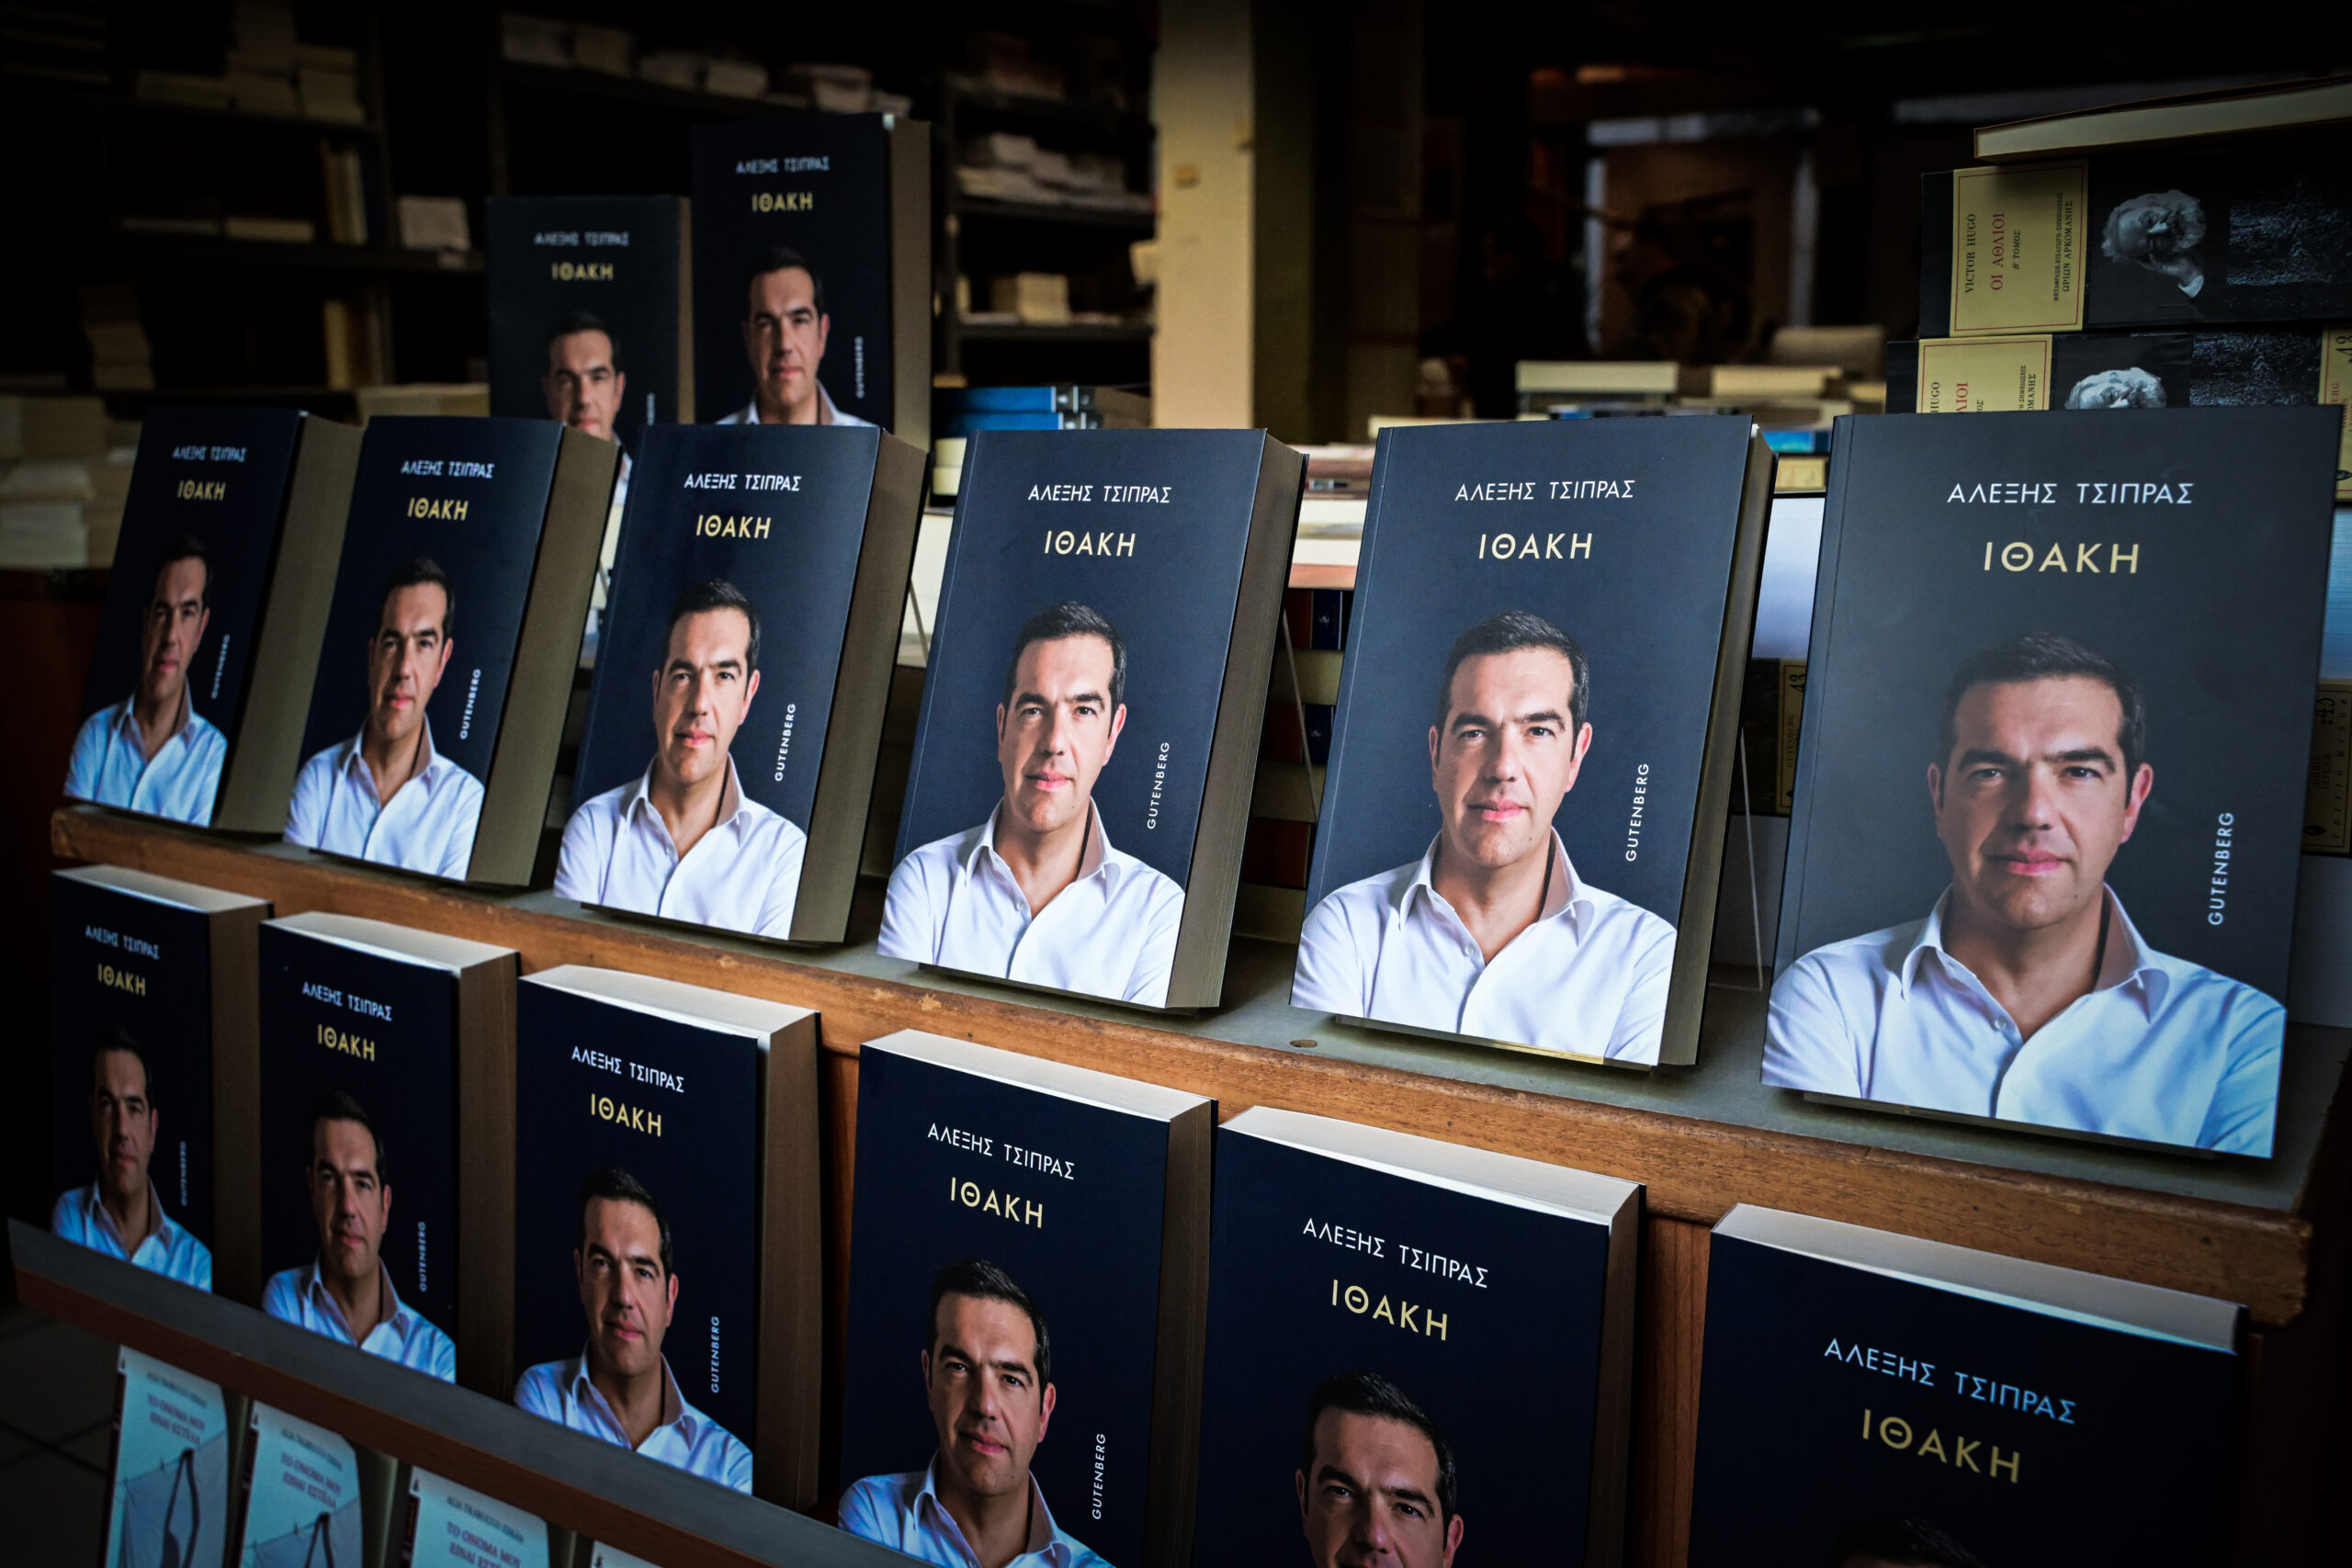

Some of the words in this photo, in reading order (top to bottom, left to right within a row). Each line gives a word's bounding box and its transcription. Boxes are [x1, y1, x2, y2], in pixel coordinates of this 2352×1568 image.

[752, 190, 813, 212] ΙΘΑΚΗ
[1966, 213, 1977, 246] HUGO
[1992, 212, 2006, 268] ΑΘΛΙΟΙ
[2012, 230, 2022, 260] ΤΟΜΟΣ
[1964, 251, 1976, 294] VICTOR
[1991, 275, 2004, 291] ΟΙ
[2063, 262, 2071, 292] ΩΡΙΩΝ
[1955, 382, 1969, 413] ΛΙΟΙ
[401, 460, 444, 476] ΑΛΕΞΗΣ
[447, 461, 495, 479] ΤΣΙΠΡΑΣ
[684, 473, 738, 490] ΑΛΕΞΗΣ
[745, 474, 802, 492] ΤΣΙΠΡΑΣ
[177, 479, 226, 501] ΙΘΑΚΗ
[407, 497, 469, 521] ΙΘΑΚΗ
[1027, 484, 1094, 502] ΑΛΕΞΗΣ
[1103, 485, 1172, 503] ΤΣΙΠΡΑΣ
[1455, 482, 1535, 501] ΑΛΕΞΗΣ
[1550, 480, 1634, 499] ΤΣΙΠΡΑΣ
[1948, 483, 2057, 503] ΑΛΕΞΗΣ
[2077, 483, 2193, 503] ΤΣΙΠΡΑΣ
[695, 514, 772, 539] ΙΘΑΚΗ
[1044, 530, 1136, 558] ΙΘΑΚΗ
[1479, 534, 1592, 558] ΙΘΑΚΗ
[1984, 542, 2138, 573] ΙΘΑΚΗ
[459, 668, 481, 740] GUTENBERG
[775, 703, 797, 782] GUTENBERG
[1147, 742, 1170, 829] GUTENBERG
[1626, 764, 1648, 861] GUTENBERG
[2208, 813, 2233, 925] GUTENBERG
[97, 964, 146, 997] ΙΘΑΚΗ
[301, 981, 343, 1009] ΑΛΕΞΗΣ
[347, 994, 392, 1022] ΤΣΙΠΡΑΣ
[317, 1022, 375, 1062] ΙΘΑΚΗ
[571, 1045, 622, 1077] ΑΛΕΞΗΣ
[628, 1062, 684, 1093] ΤΣΙΠΡΑΣ
[591, 1093, 662, 1137] ΙΘΑΚΗ
[927, 1122, 993, 1159] ΑΛΕΞΗΣ
[1003, 1144, 1075, 1180] ΤΣΙΠΡΑΣ
[950, 1177, 1043, 1228] ΙΘΑΚΗ
[1304, 1218, 1385, 1258] ΑΛΕΞΗΣ
[1399, 1245, 1487, 1290] ΤΣΙΠΡΑΣ
[1332, 1279, 1449, 1340] ΙΘΑΚΗ
[710, 1316, 720, 1393] GUTENBERG
[1824, 1338, 1936, 1390] ΑΛΕΞΗΣ
[1955, 1372, 2075, 1424] ΤΣΙΠΡΑΣ
[1863, 1408, 2022, 1483] ΙΘΑΚΗ
[1091, 1433, 1106, 1520] GUTENBERG
